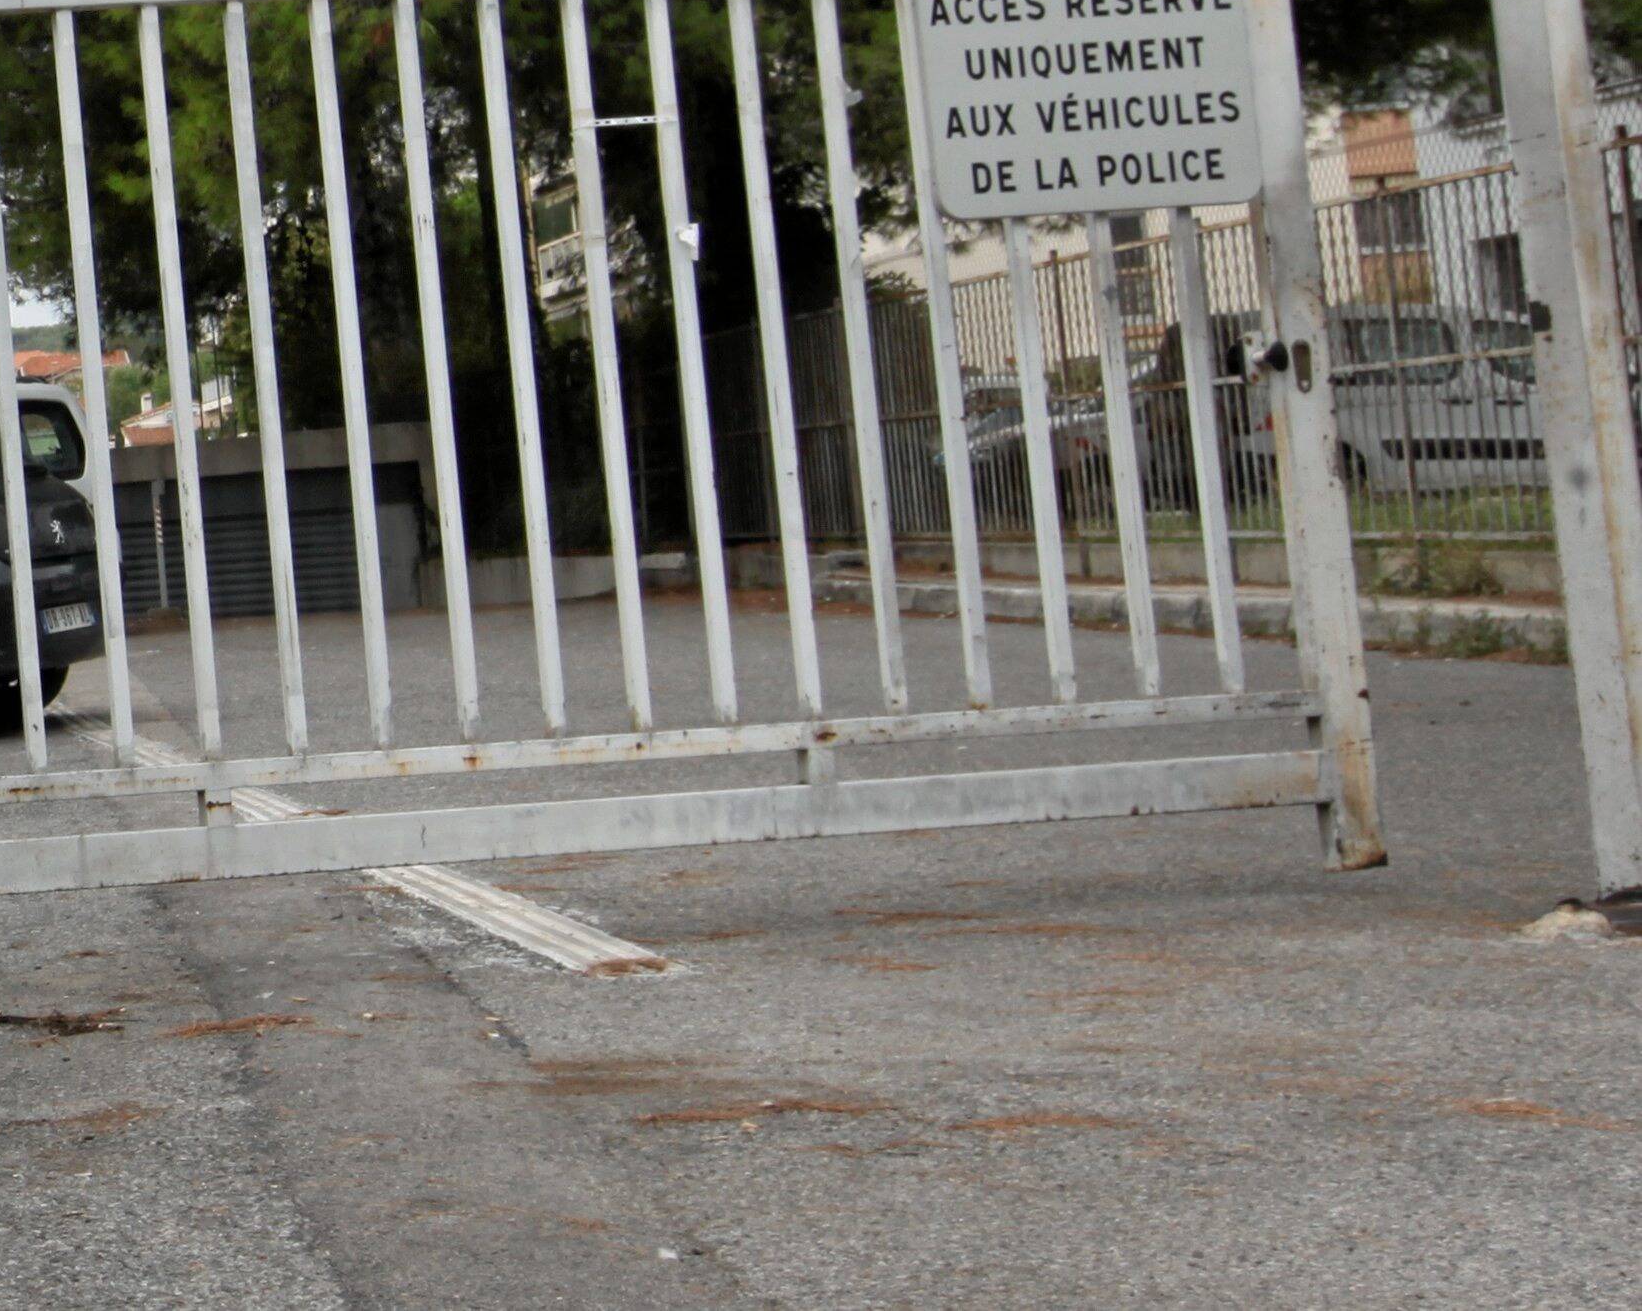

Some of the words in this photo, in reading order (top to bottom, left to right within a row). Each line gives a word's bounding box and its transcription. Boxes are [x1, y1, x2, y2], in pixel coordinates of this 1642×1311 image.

[964, 36, 1205, 81] UNIQUEMENT
[946, 103, 1016, 139] AUX
[1035, 90, 1240, 134] VÉHICULES
[971, 160, 1017, 195] DE
[1034, 157, 1078, 191] LA
[1096, 147, 1225, 187] POLICE
